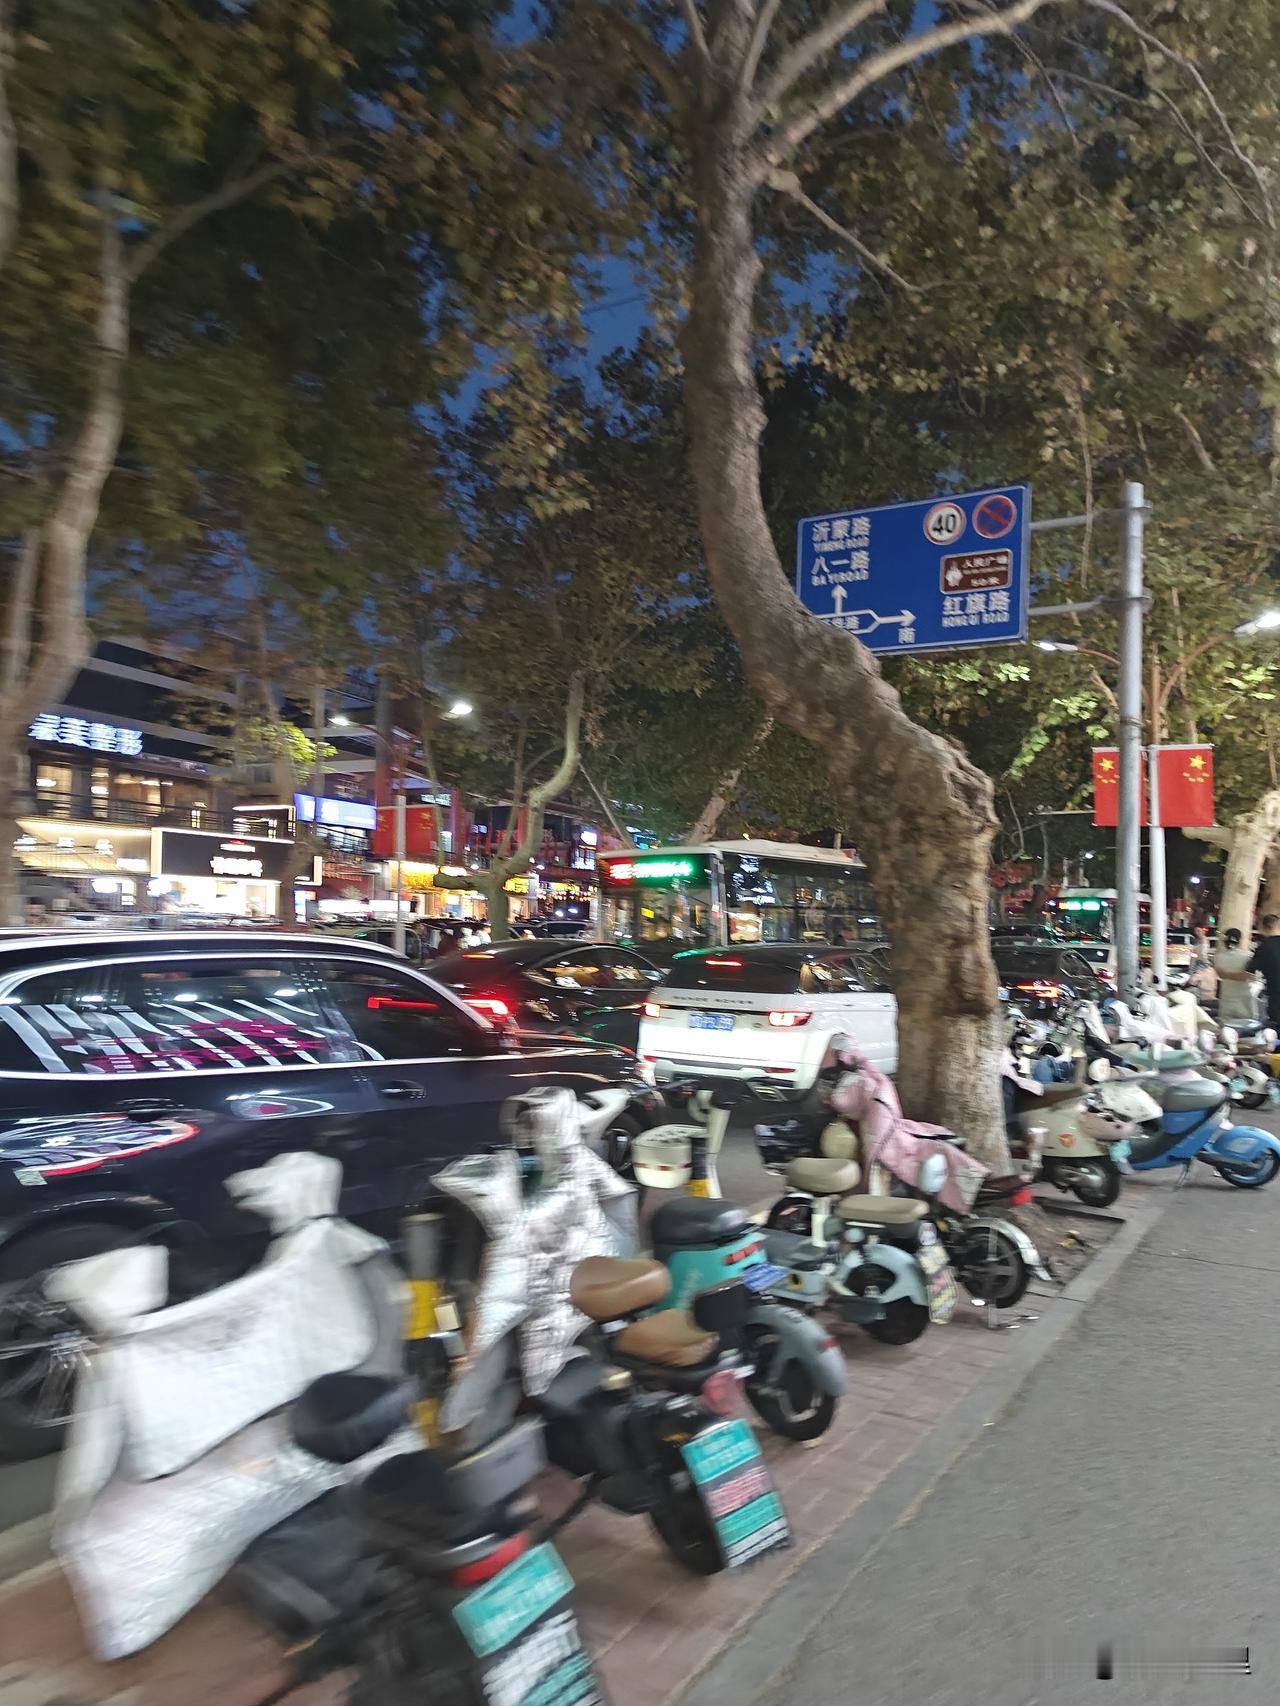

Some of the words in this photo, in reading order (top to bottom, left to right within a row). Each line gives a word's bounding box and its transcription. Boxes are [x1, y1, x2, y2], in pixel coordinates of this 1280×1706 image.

[811, 516, 871, 543] 沂蒙路
[933, 513, 956, 535] 40
[846, 536, 870, 549] ROAD
[811, 549, 870, 574] 八一路
[942, 590, 1010, 615] 红旗路
[982, 611, 1009, 624] ROAD
